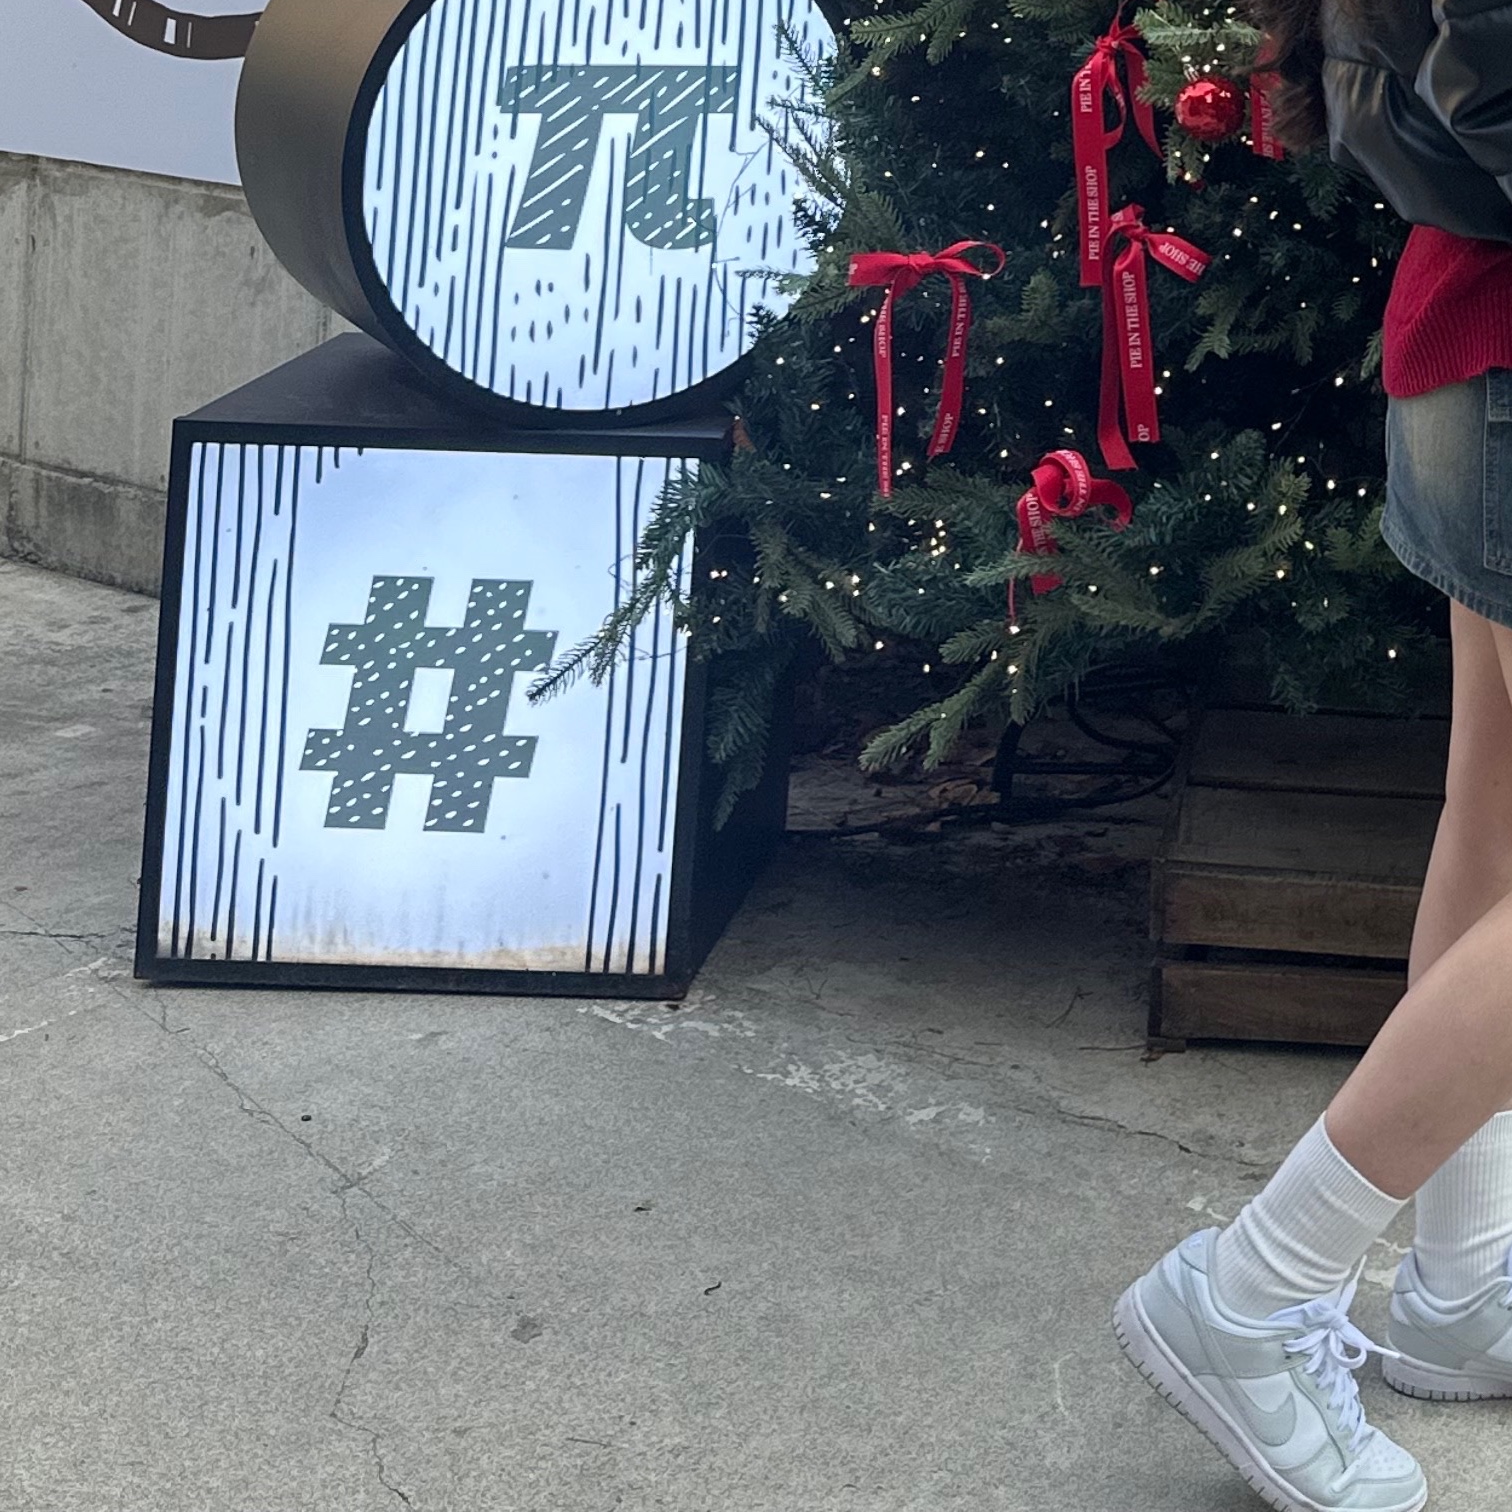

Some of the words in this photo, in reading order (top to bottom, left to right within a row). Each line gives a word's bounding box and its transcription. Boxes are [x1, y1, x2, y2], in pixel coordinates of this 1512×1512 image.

[1079, 78, 1090, 90] IN
[1080, 93, 1092, 112] PIE
[1085, 165, 1097, 196] SHOP
[1087, 198, 1098, 222] THE
[1088, 225, 1098, 237] IN
[1089, 240, 1099, 259] PIE
[1157, 239, 1190, 265] SHOP
[1186, 258, 1205, 275] HE
[1122, 271, 1136, 303] SHOP
[956, 293, 968, 320] THE
[1126, 304, 1139, 330] THE
[955, 322, 963, 335] IN
[1128, 332, 1140, 345] IN
[951, 336, 961, 357] PIE
[1129, 347, 1142, 368] PIE
[1026, 491, 1042, 524] SHOP
